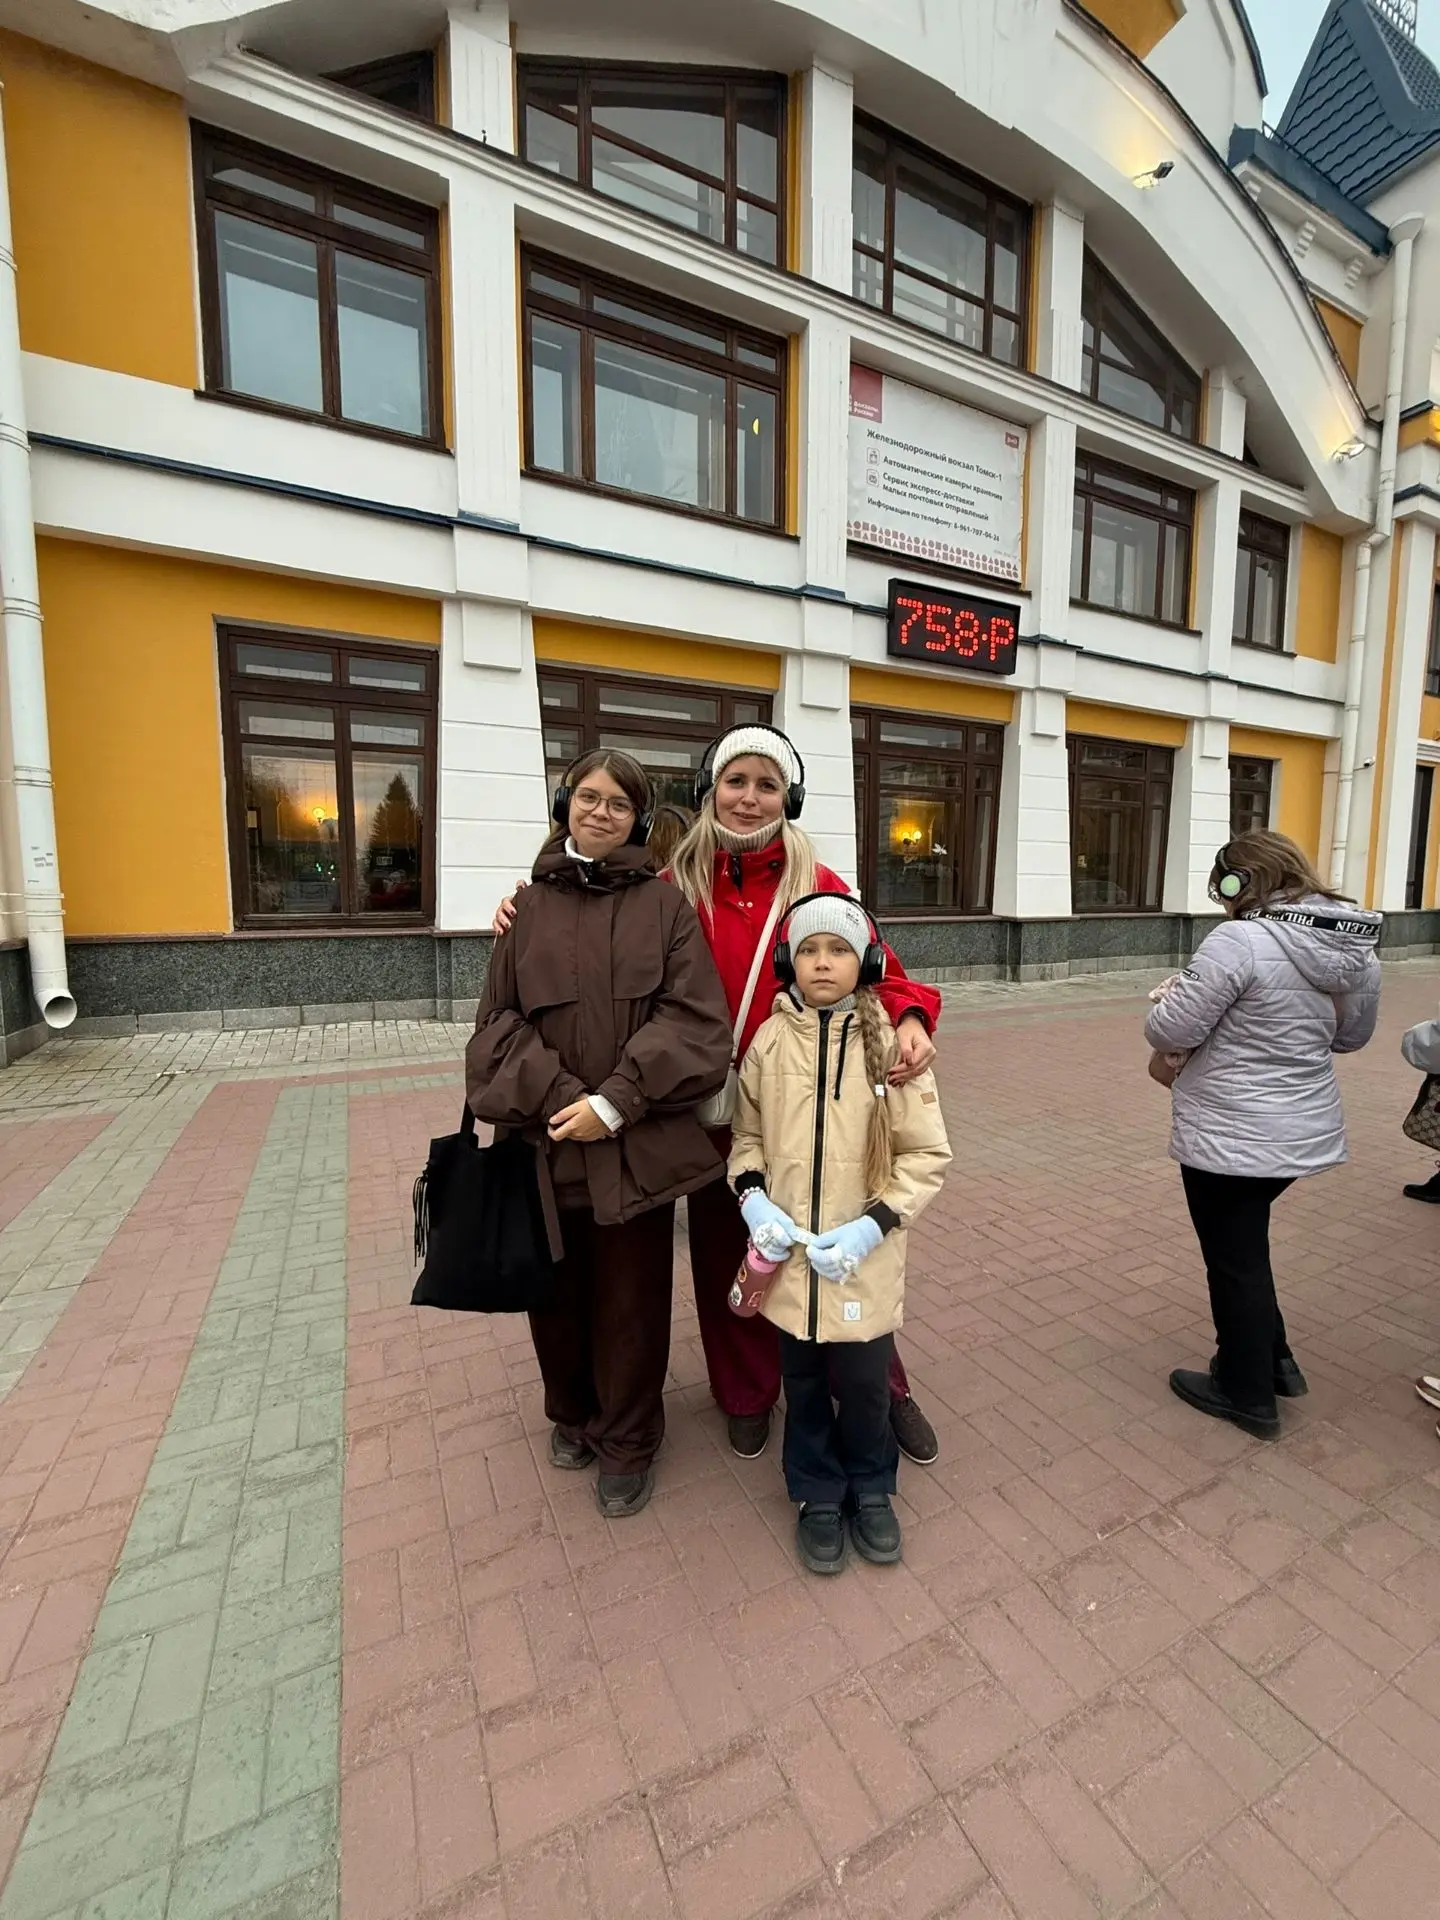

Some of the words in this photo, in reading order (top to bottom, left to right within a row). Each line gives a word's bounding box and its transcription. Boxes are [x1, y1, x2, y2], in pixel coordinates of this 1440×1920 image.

[867, 428, 947, 462] Железнодорожный
[948, 457, 974, 471] вокзал
[976, 464, 1002, 481] Томск-1
[883, 456, 944, 481] Автоматические
[945, 475, 972, 490] камеры
[973, 485, 1003, 501] хранения
[883, 472, 909, 487] Сервис
[910, 481, 975, 506] экспресс-доставки
[867, 496, 911, 516] Информация
[911, 510, 920, 519] по
[882, 484, 907, 498] малых
[908, 492, 944, 508] почтовых
[945, 503, 989, 521] отправлений
[1335, 920, 1375, 936] PLEIN
